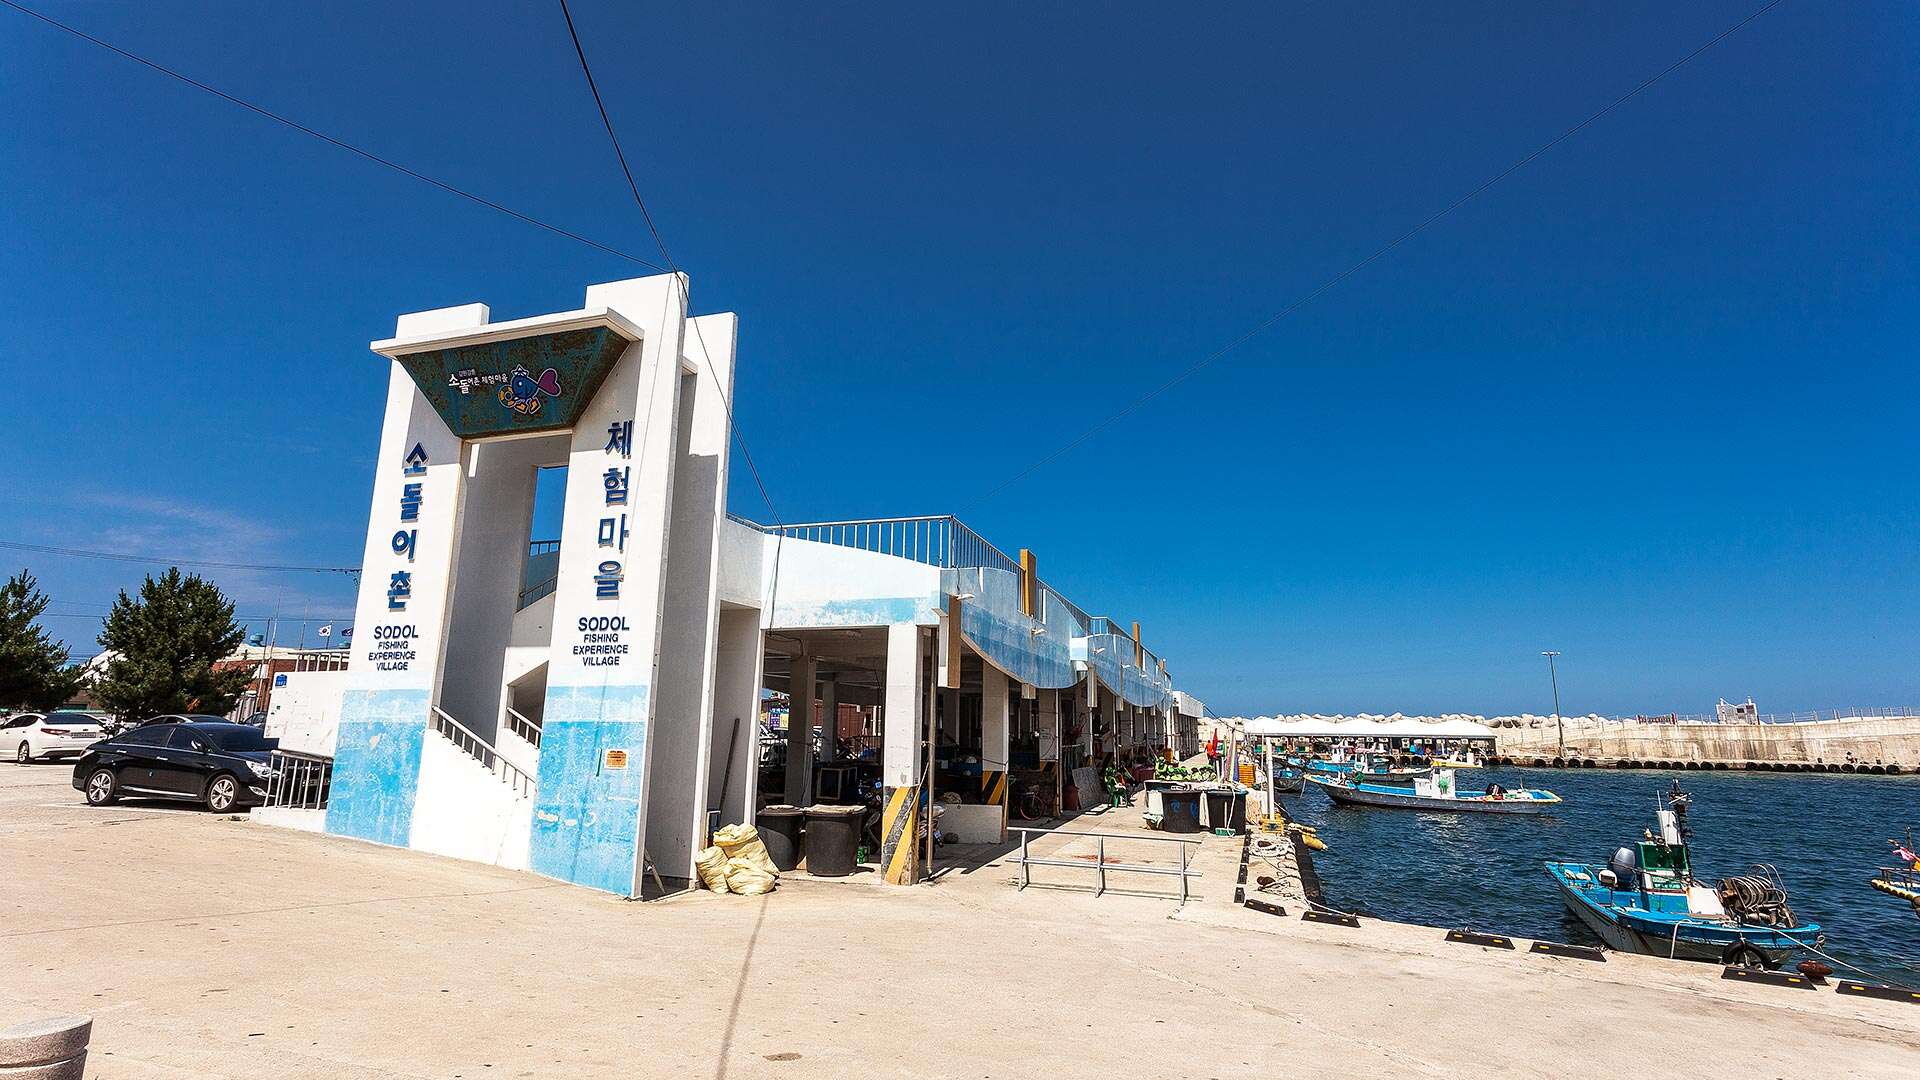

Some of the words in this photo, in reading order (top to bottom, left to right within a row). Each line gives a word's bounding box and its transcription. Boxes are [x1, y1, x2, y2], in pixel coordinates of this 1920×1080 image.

[594, 420, 634, 599] 체험마을
[387, 441, 428, 611] 소돌어촌
[578, 616, 630, 631] SODOL
[373, 624, 419, 640] SODOL
[583, 633, 619, 643] FISHING
[378, 640, 409, 650] FISHING
[573, 644, 628, 655] EXPERIENCE
[368, 650, 416, 661] EXPERIENCE
[376, 661, 409, 671] VILLAGE
[582, 656, 620, 667] VILLAGE
